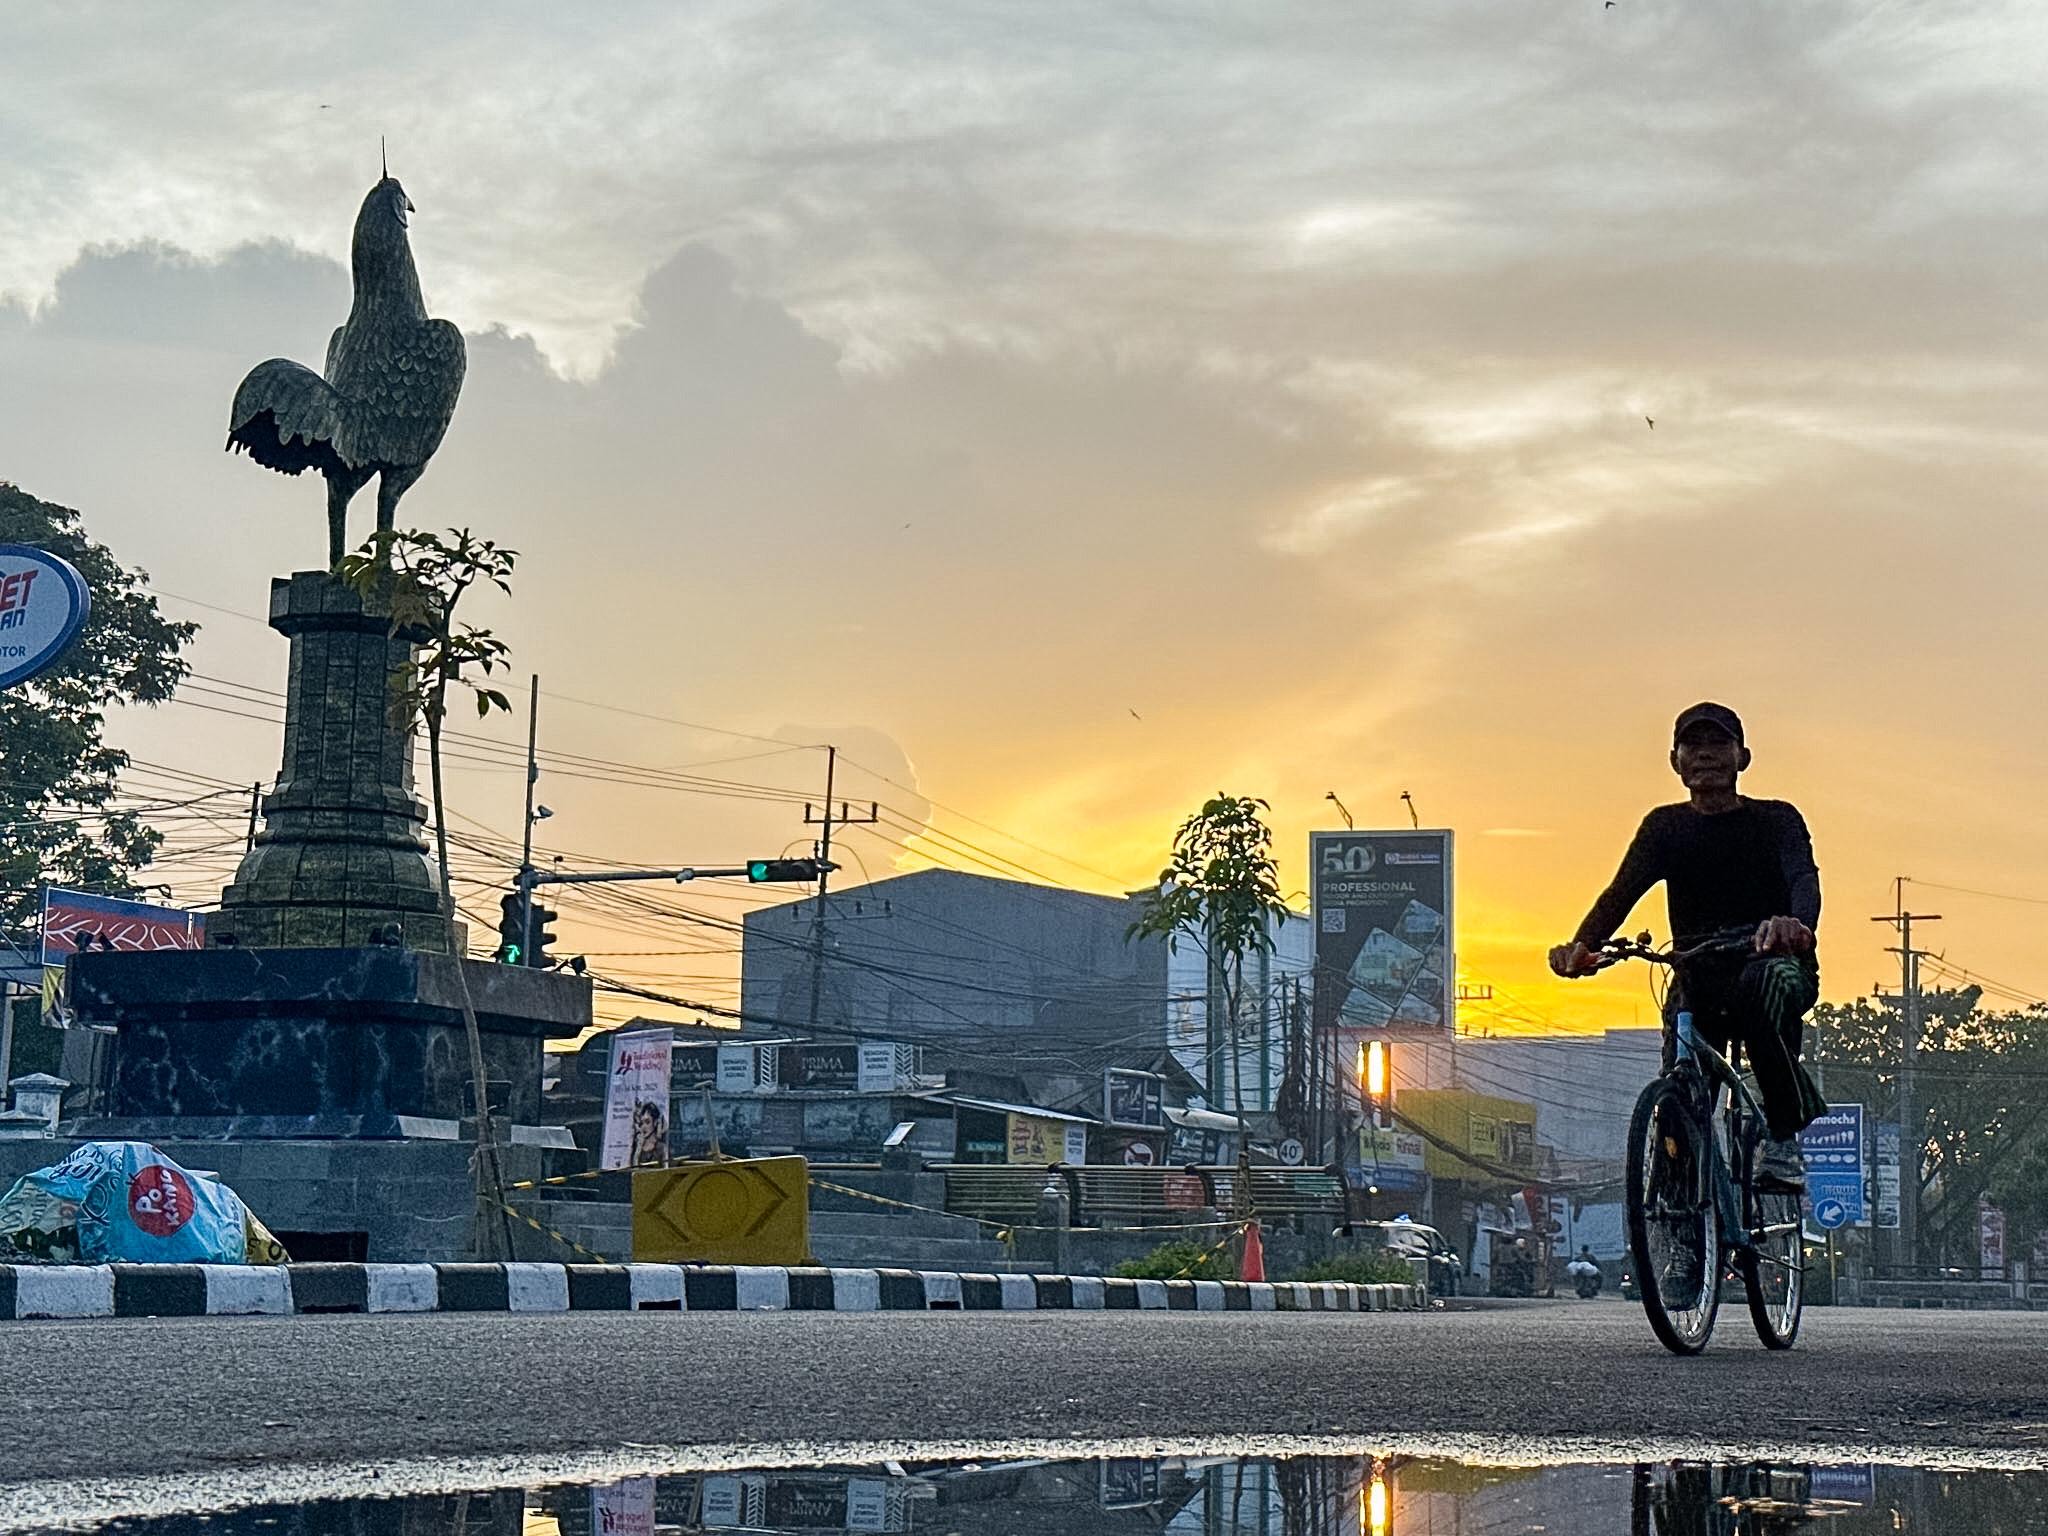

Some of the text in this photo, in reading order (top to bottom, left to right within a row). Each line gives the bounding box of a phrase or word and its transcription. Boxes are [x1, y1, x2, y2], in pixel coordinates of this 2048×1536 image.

[0, 569, 39, 611] ET
[0, 646, 26, 657] TOR
[1322, 882, 1416, 893] PROFESSIONAL
[671, 1058, 702, 1071] IMA
[801, 1056, 844, 1070] PRIMA
[1811, 1113, 1855, 1124] nnochs
[1281, 1145, 1297, 1158] 40
